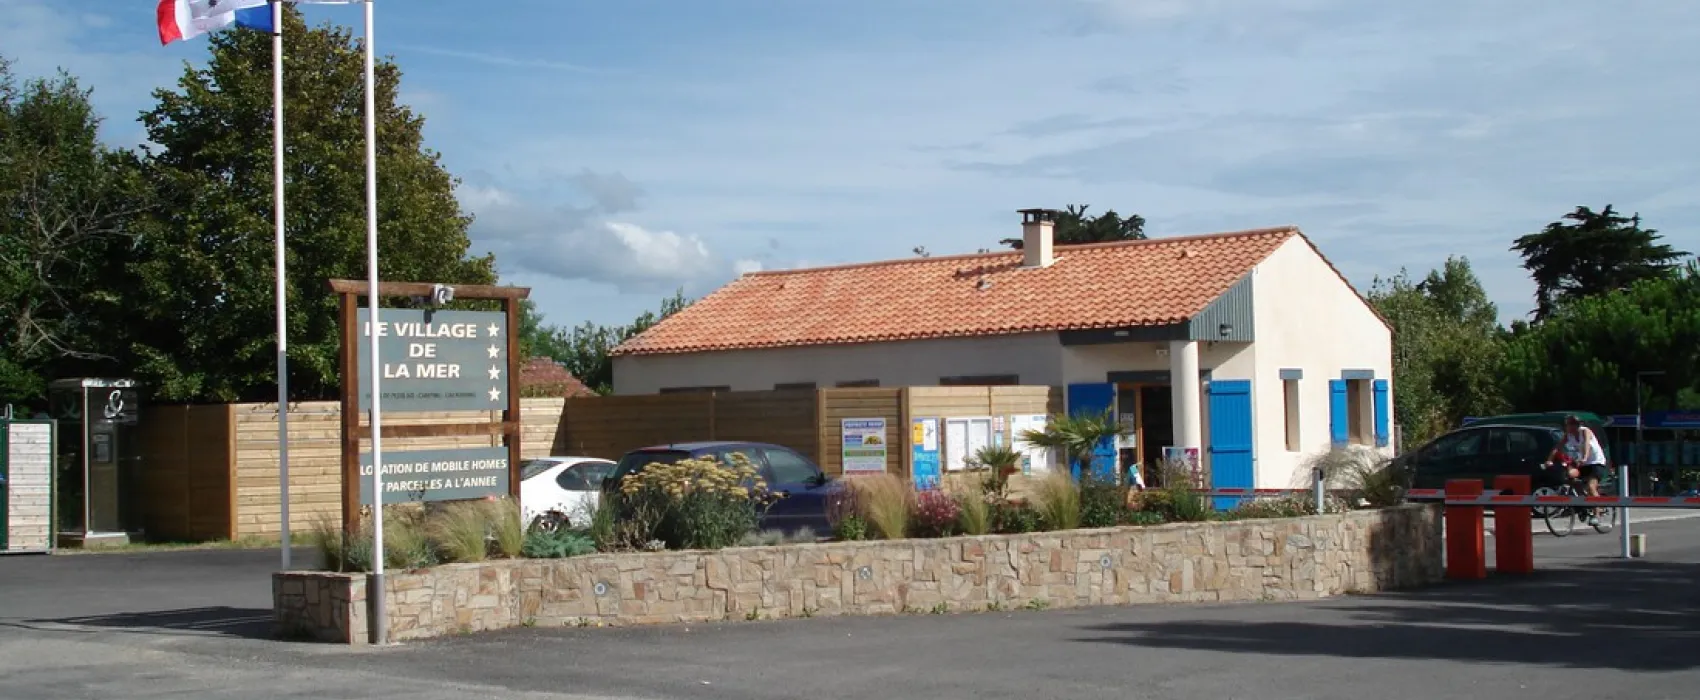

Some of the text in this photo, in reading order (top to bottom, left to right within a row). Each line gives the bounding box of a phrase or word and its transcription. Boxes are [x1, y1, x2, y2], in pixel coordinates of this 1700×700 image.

[393, 322, 477, 338] VILLAGE
[409, 343, 437, 358] DE
[384, 363, 460, 379] LA MER
[360, 459, 508, 476] LOATION DE MOBILE HOMES
[444, 479, 452, 488] A
